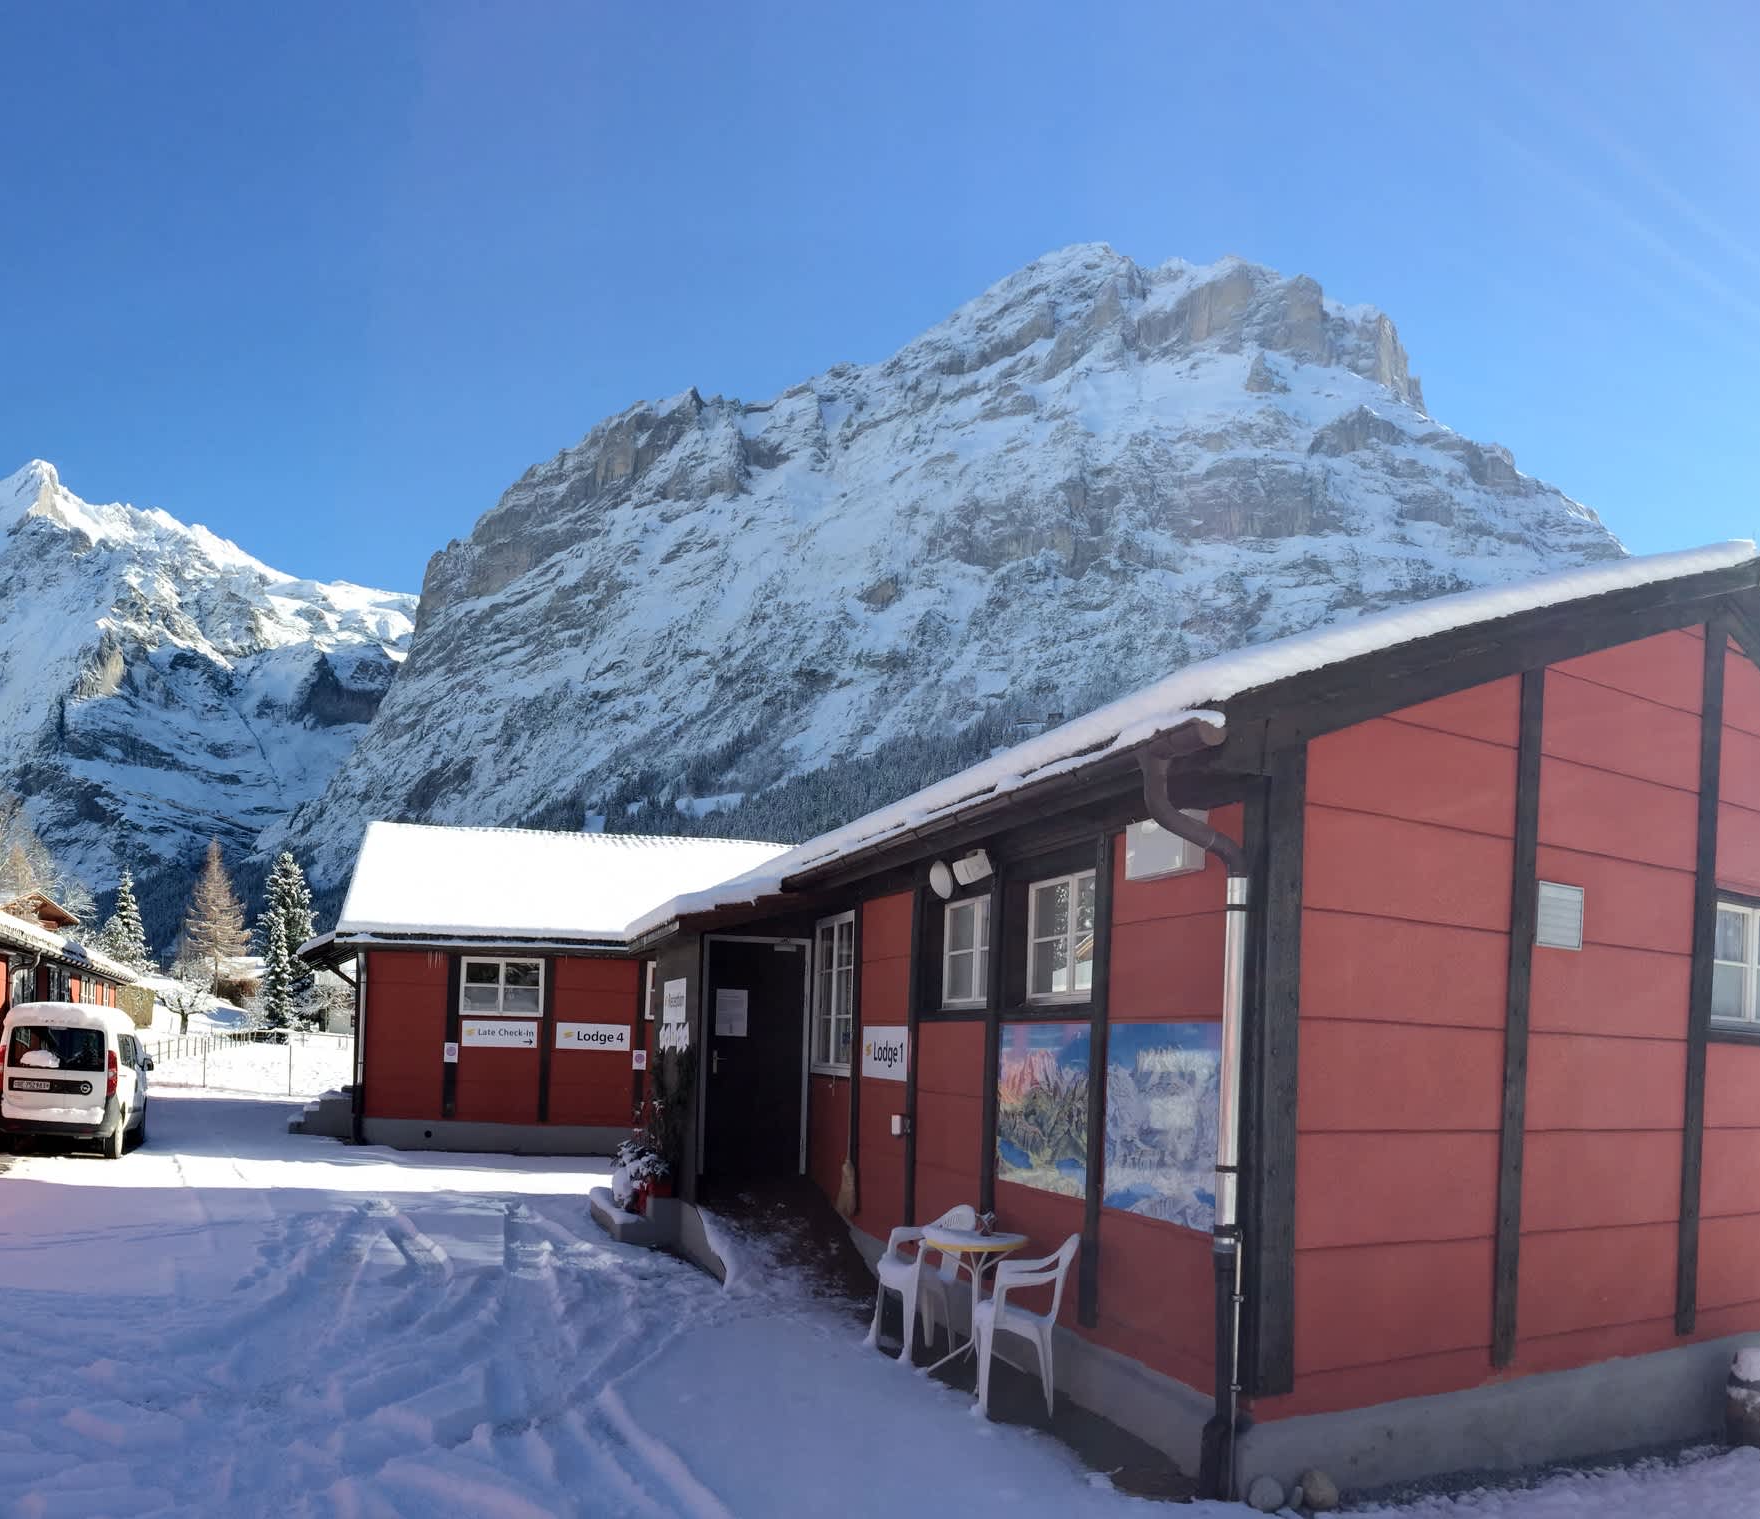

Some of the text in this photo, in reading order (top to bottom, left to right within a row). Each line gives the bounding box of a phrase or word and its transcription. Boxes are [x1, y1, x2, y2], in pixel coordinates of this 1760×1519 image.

[478, 1028, 496, 1036] Late
[577, 1030, 624, 1045] Lodge 4
[873, 1040, 904, 1068] Lodge 1
